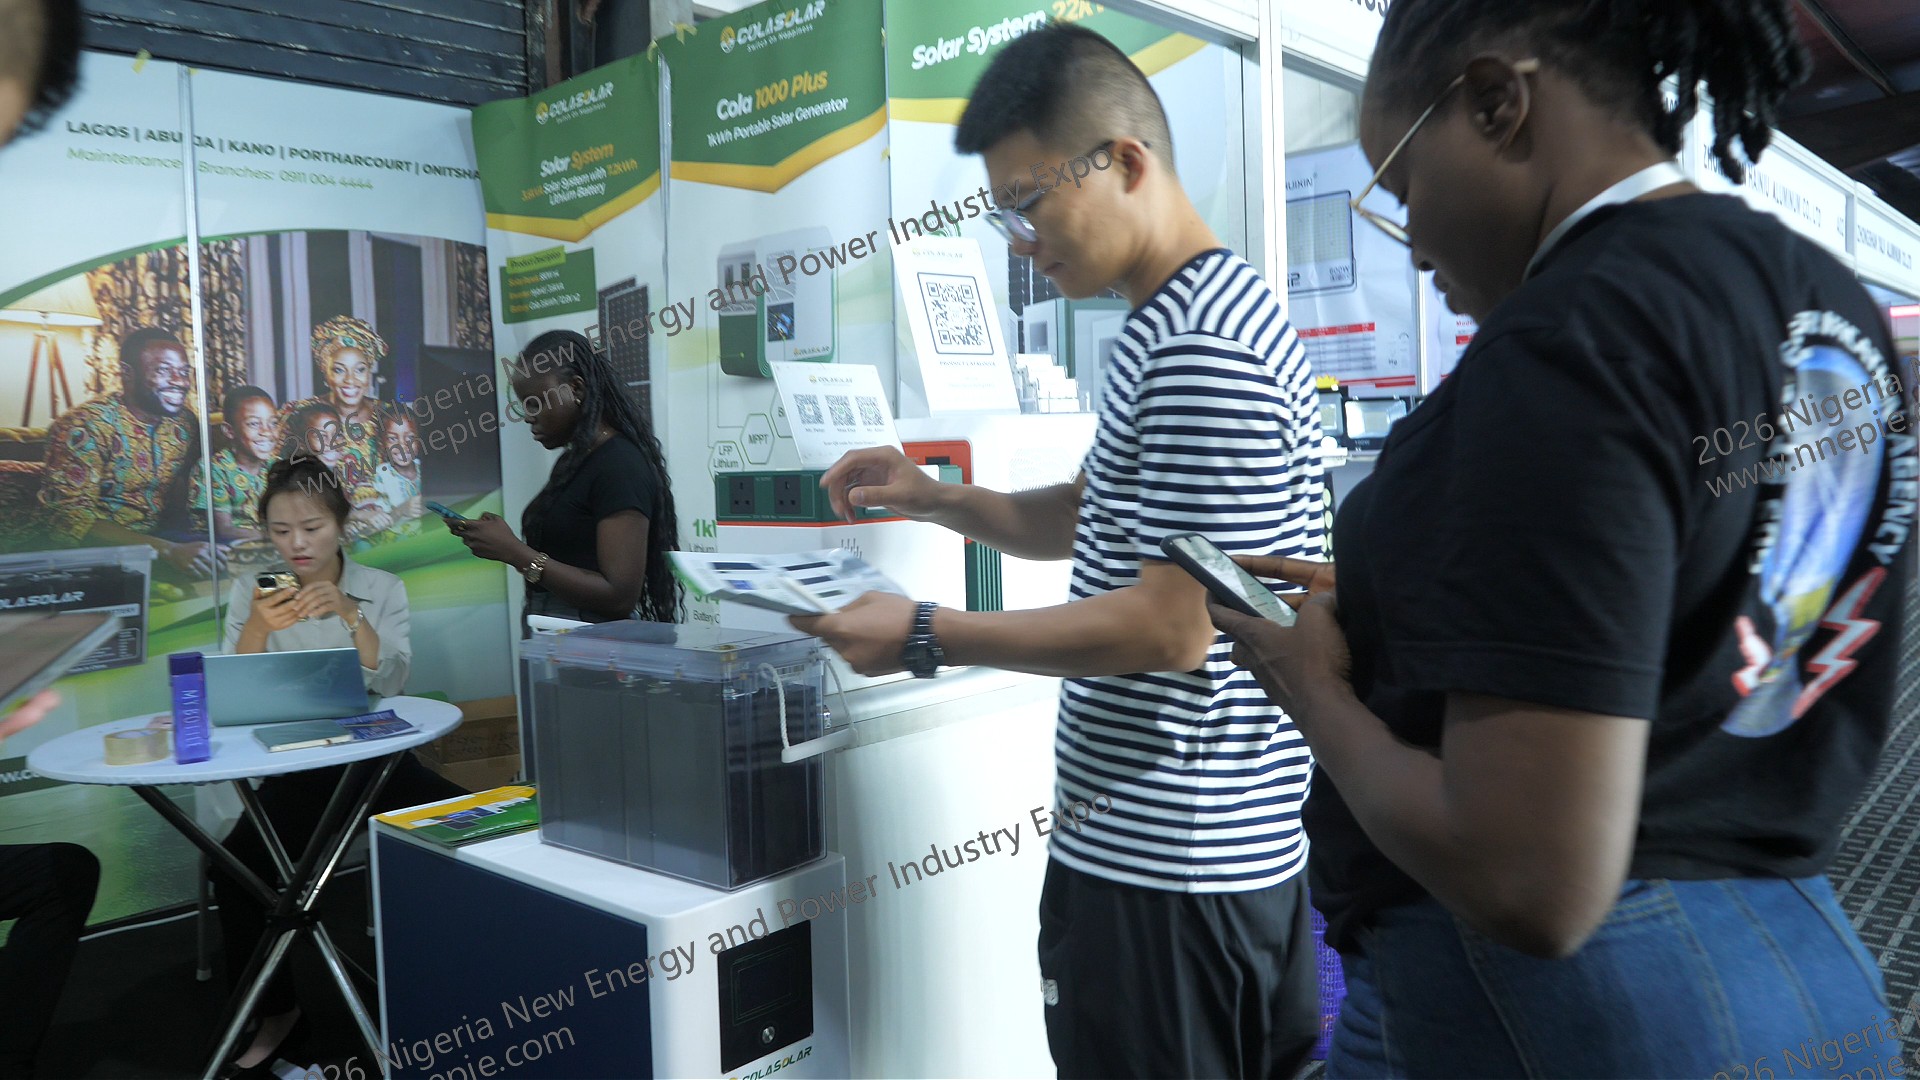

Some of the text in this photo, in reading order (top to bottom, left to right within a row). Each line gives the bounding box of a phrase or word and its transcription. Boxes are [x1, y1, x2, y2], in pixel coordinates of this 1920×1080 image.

[736, 0, 826, 45] COLASOLAR
[911, 35, 965, 70] Solar
[965, 9, 1047, 55] System
[716, 70, 829, 121] Cola 1000 Plus
[733, 117, 773, 140] Portable
[770, 111, 795, 130] Solar
[794, 97, 849, 121] Generator
[66, 120, 130, 139] LAGOS
[228, 139, 275, 156] KANO
[288, 147, 412, 173] PORTHARCOURT
[423, 163, 480, 180] ONITSHA
[67, 147, 184, 169] Maintenance
[540, 155, 571, 178] Solar
[748, 433, 770, 445] MPPT
[713, 457, 739, 469] Lithium
[693, 610, 714, 624] Battery
